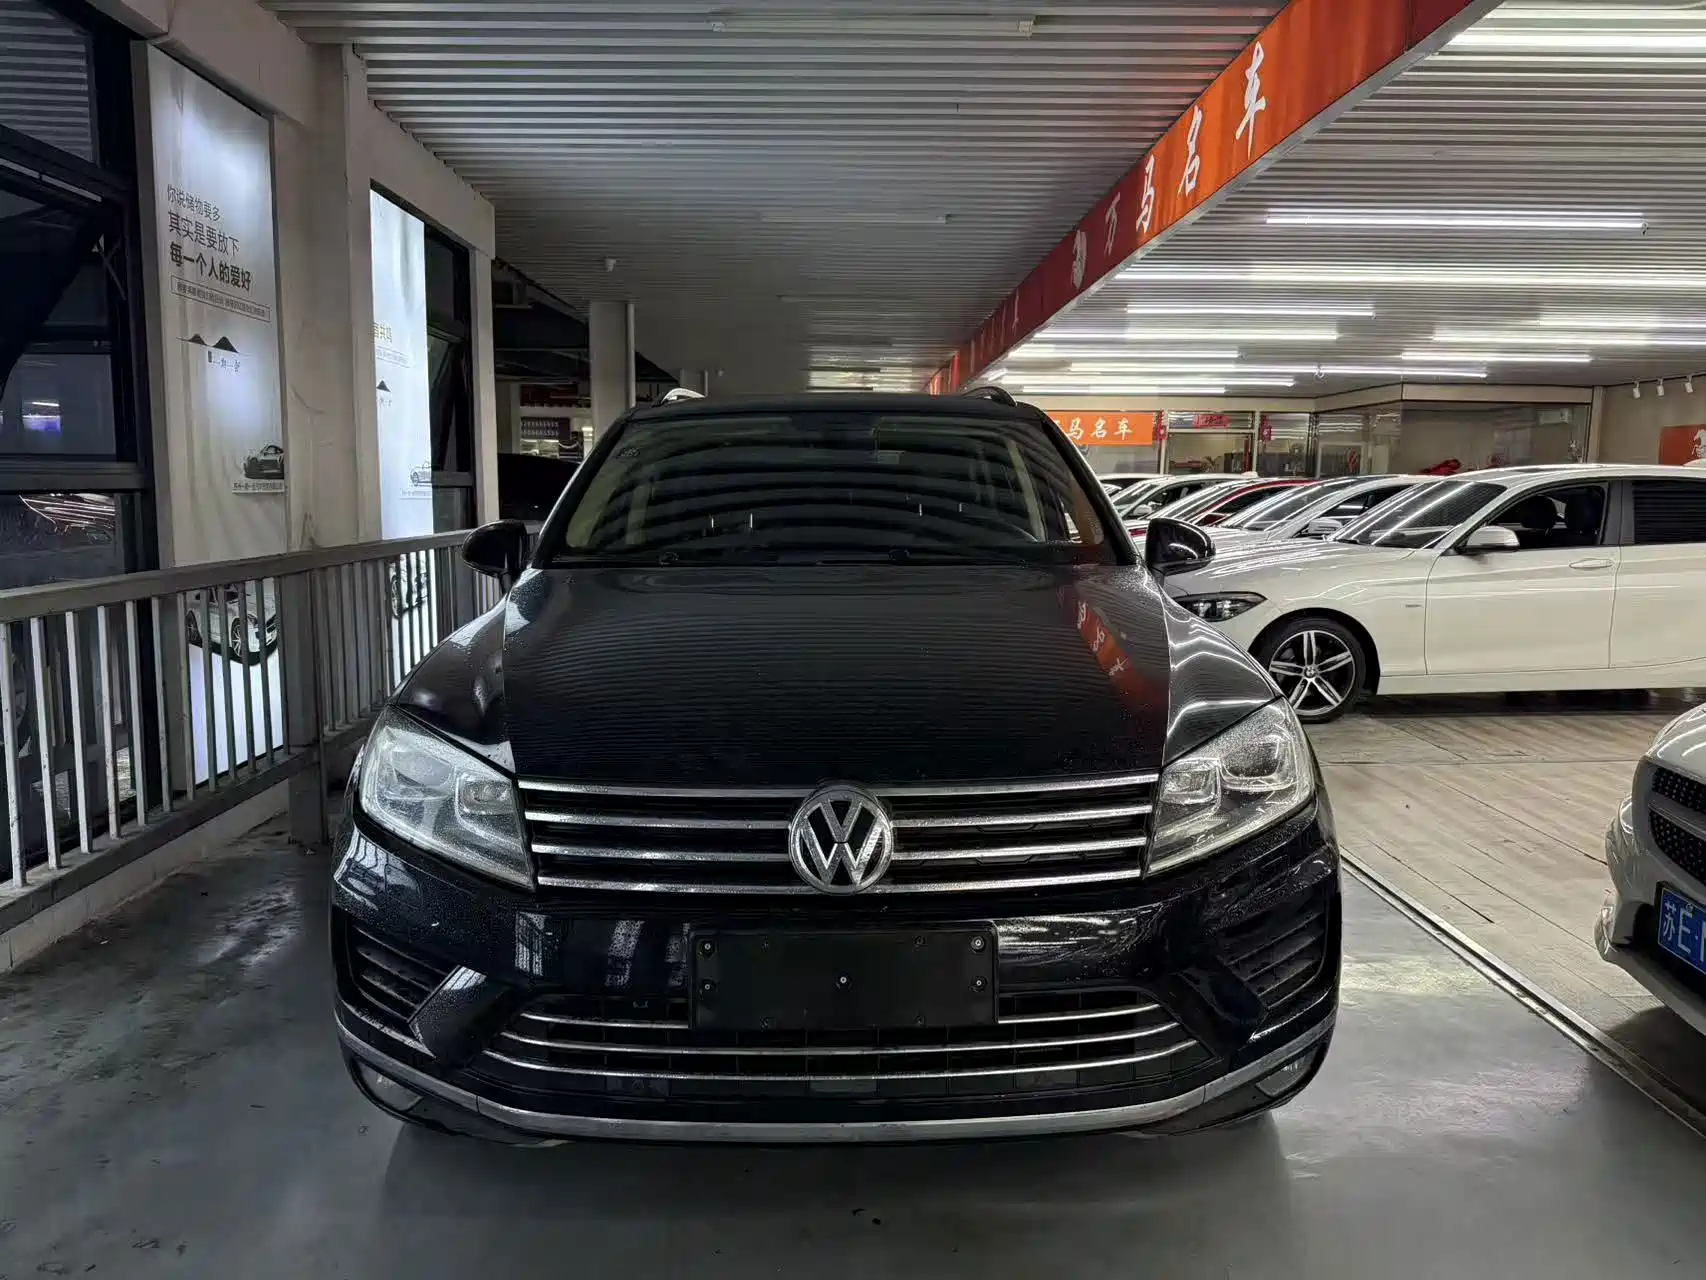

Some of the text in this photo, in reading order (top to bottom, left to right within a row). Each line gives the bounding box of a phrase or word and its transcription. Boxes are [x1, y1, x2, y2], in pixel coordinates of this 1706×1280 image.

[1104, 41, 1266, 257] 万马名车
[168, 210, 240, 256] 其实是要放下
[170, 241, 251, 292] 每一个人的爱好
[1055, 416, 1133, 441] 马名车
[789, 785, 892, 894] VW
